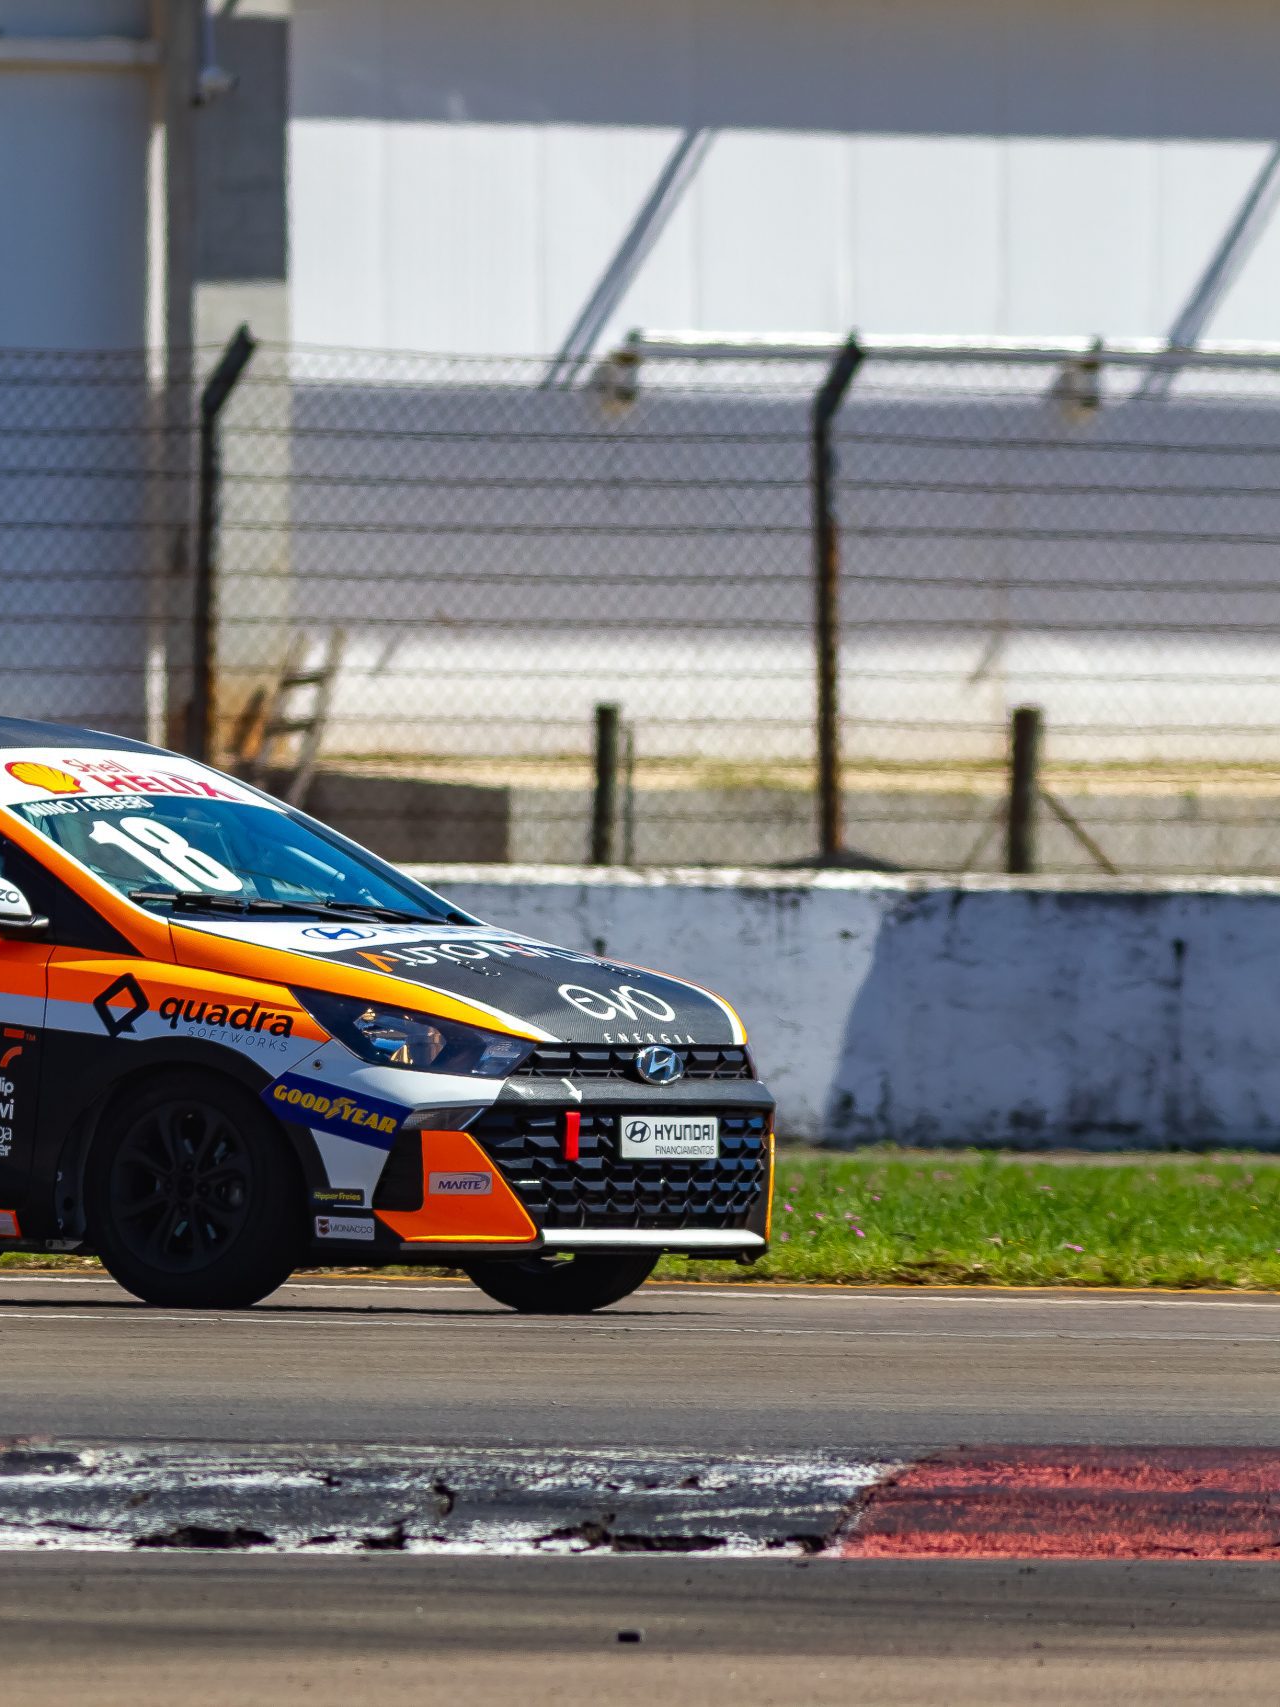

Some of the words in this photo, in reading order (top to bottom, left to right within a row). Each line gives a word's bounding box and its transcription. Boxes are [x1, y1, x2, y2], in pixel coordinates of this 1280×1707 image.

[62, 759, 135, 774] Shell
[87, 770, 246, 801] HELIX
[89, 816, 244, 893] 18
[158, 996, 295, 1038] quadra
[186, 1026, 289, 1052] SOFTWORKS
[602, 1032, 697, 1044] ENERGIA
[654, 1124, 715, 1141] HYUNDAI
[654, 1145, 715, 1156] FINANCIAMENTOS
[438, 1180, 482, 1190] MARTE
